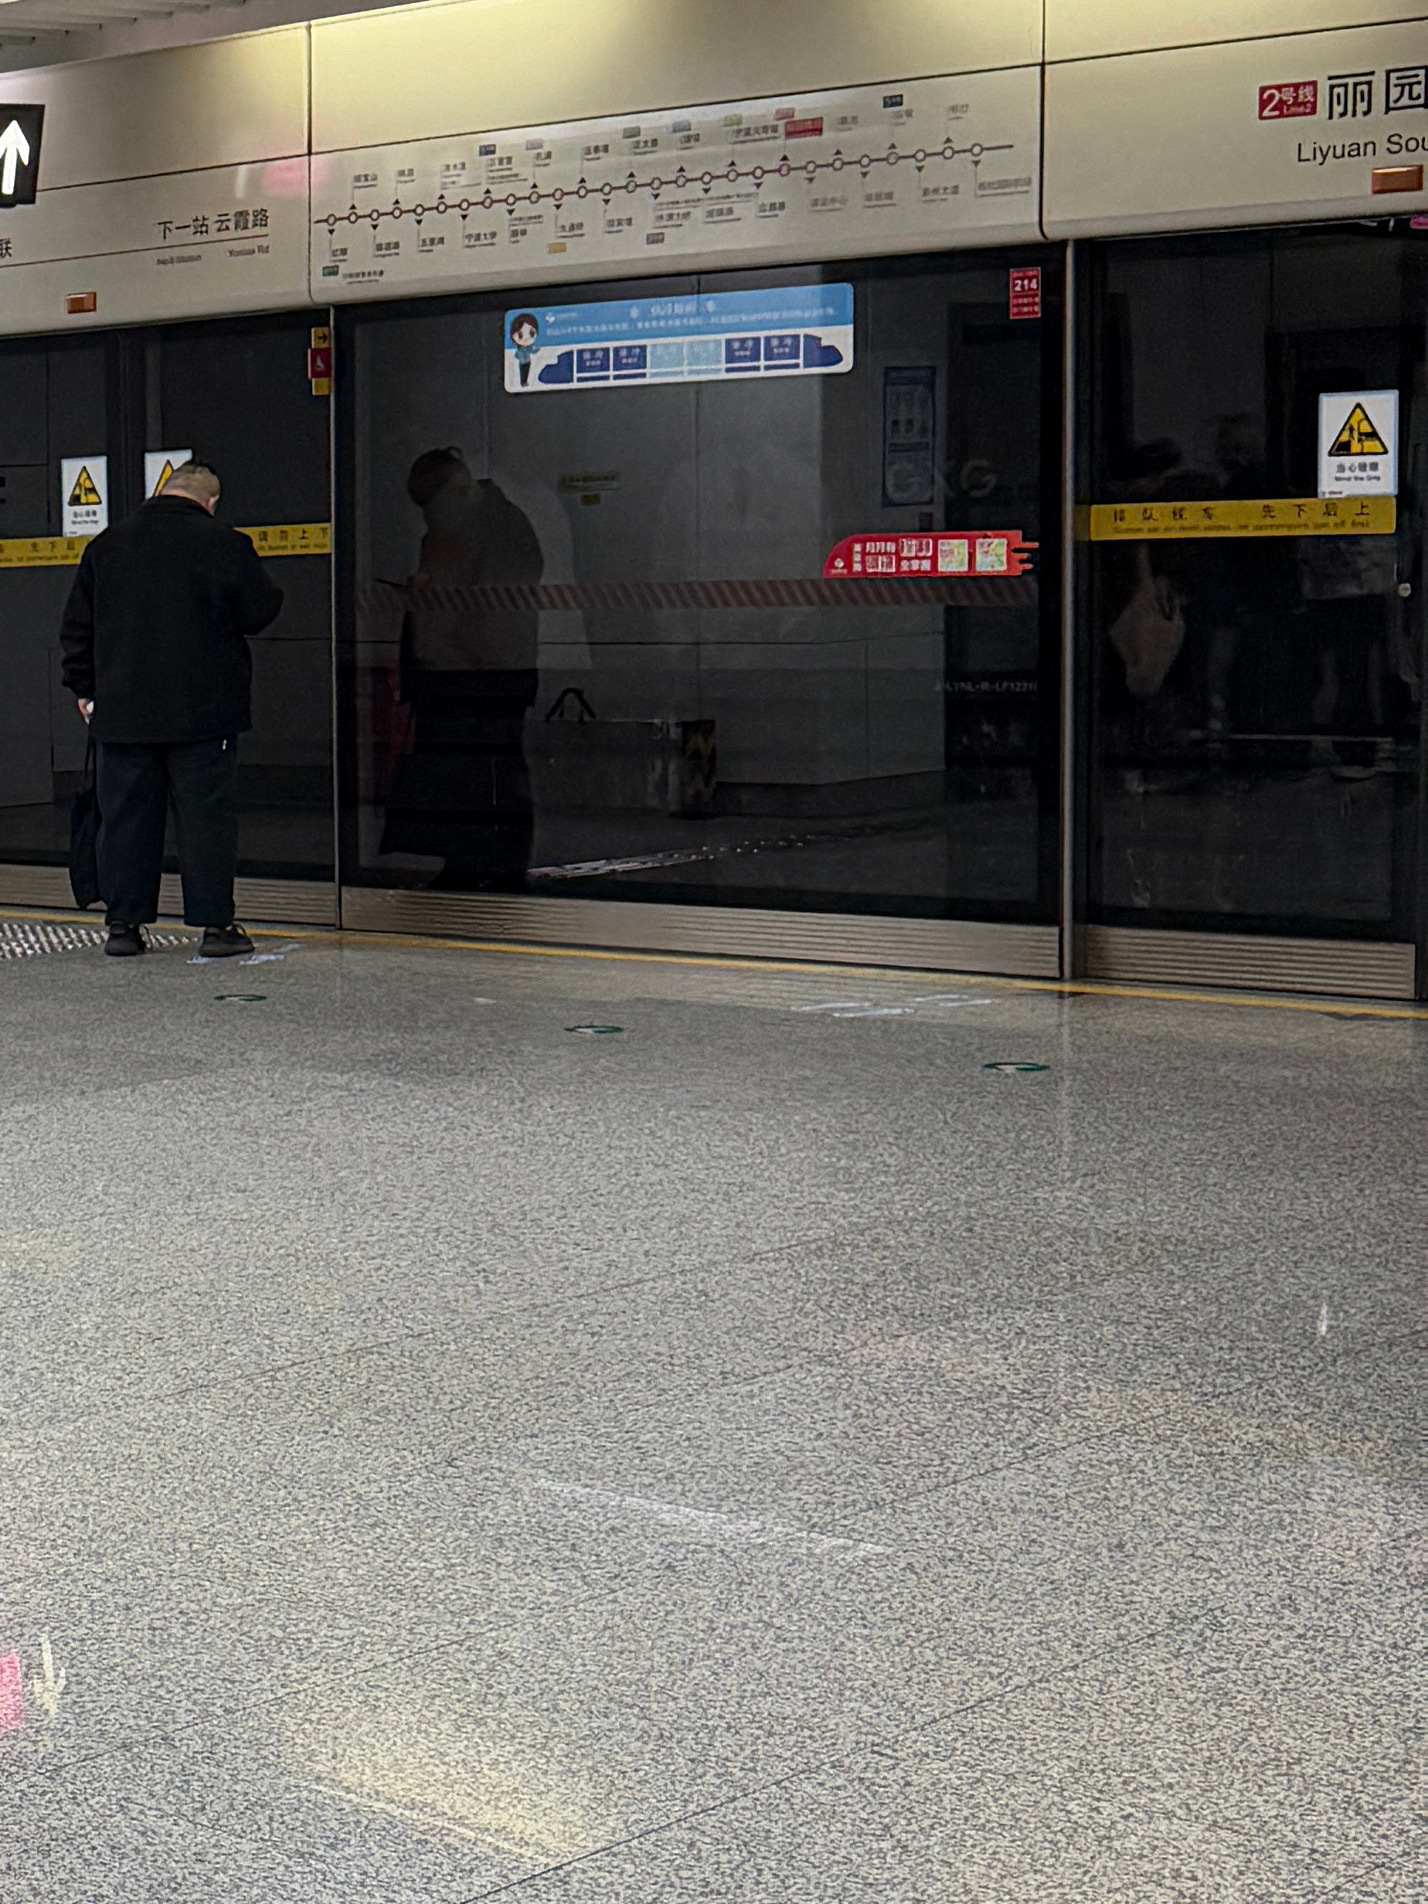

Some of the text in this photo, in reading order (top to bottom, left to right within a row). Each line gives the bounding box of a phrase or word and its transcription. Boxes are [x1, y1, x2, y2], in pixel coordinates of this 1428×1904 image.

[1297, 140, 1376, 166] Liyuan
[157, 207, 269, 240] 下一站 云霞路
[1014, 279, 1038, 291] 214
